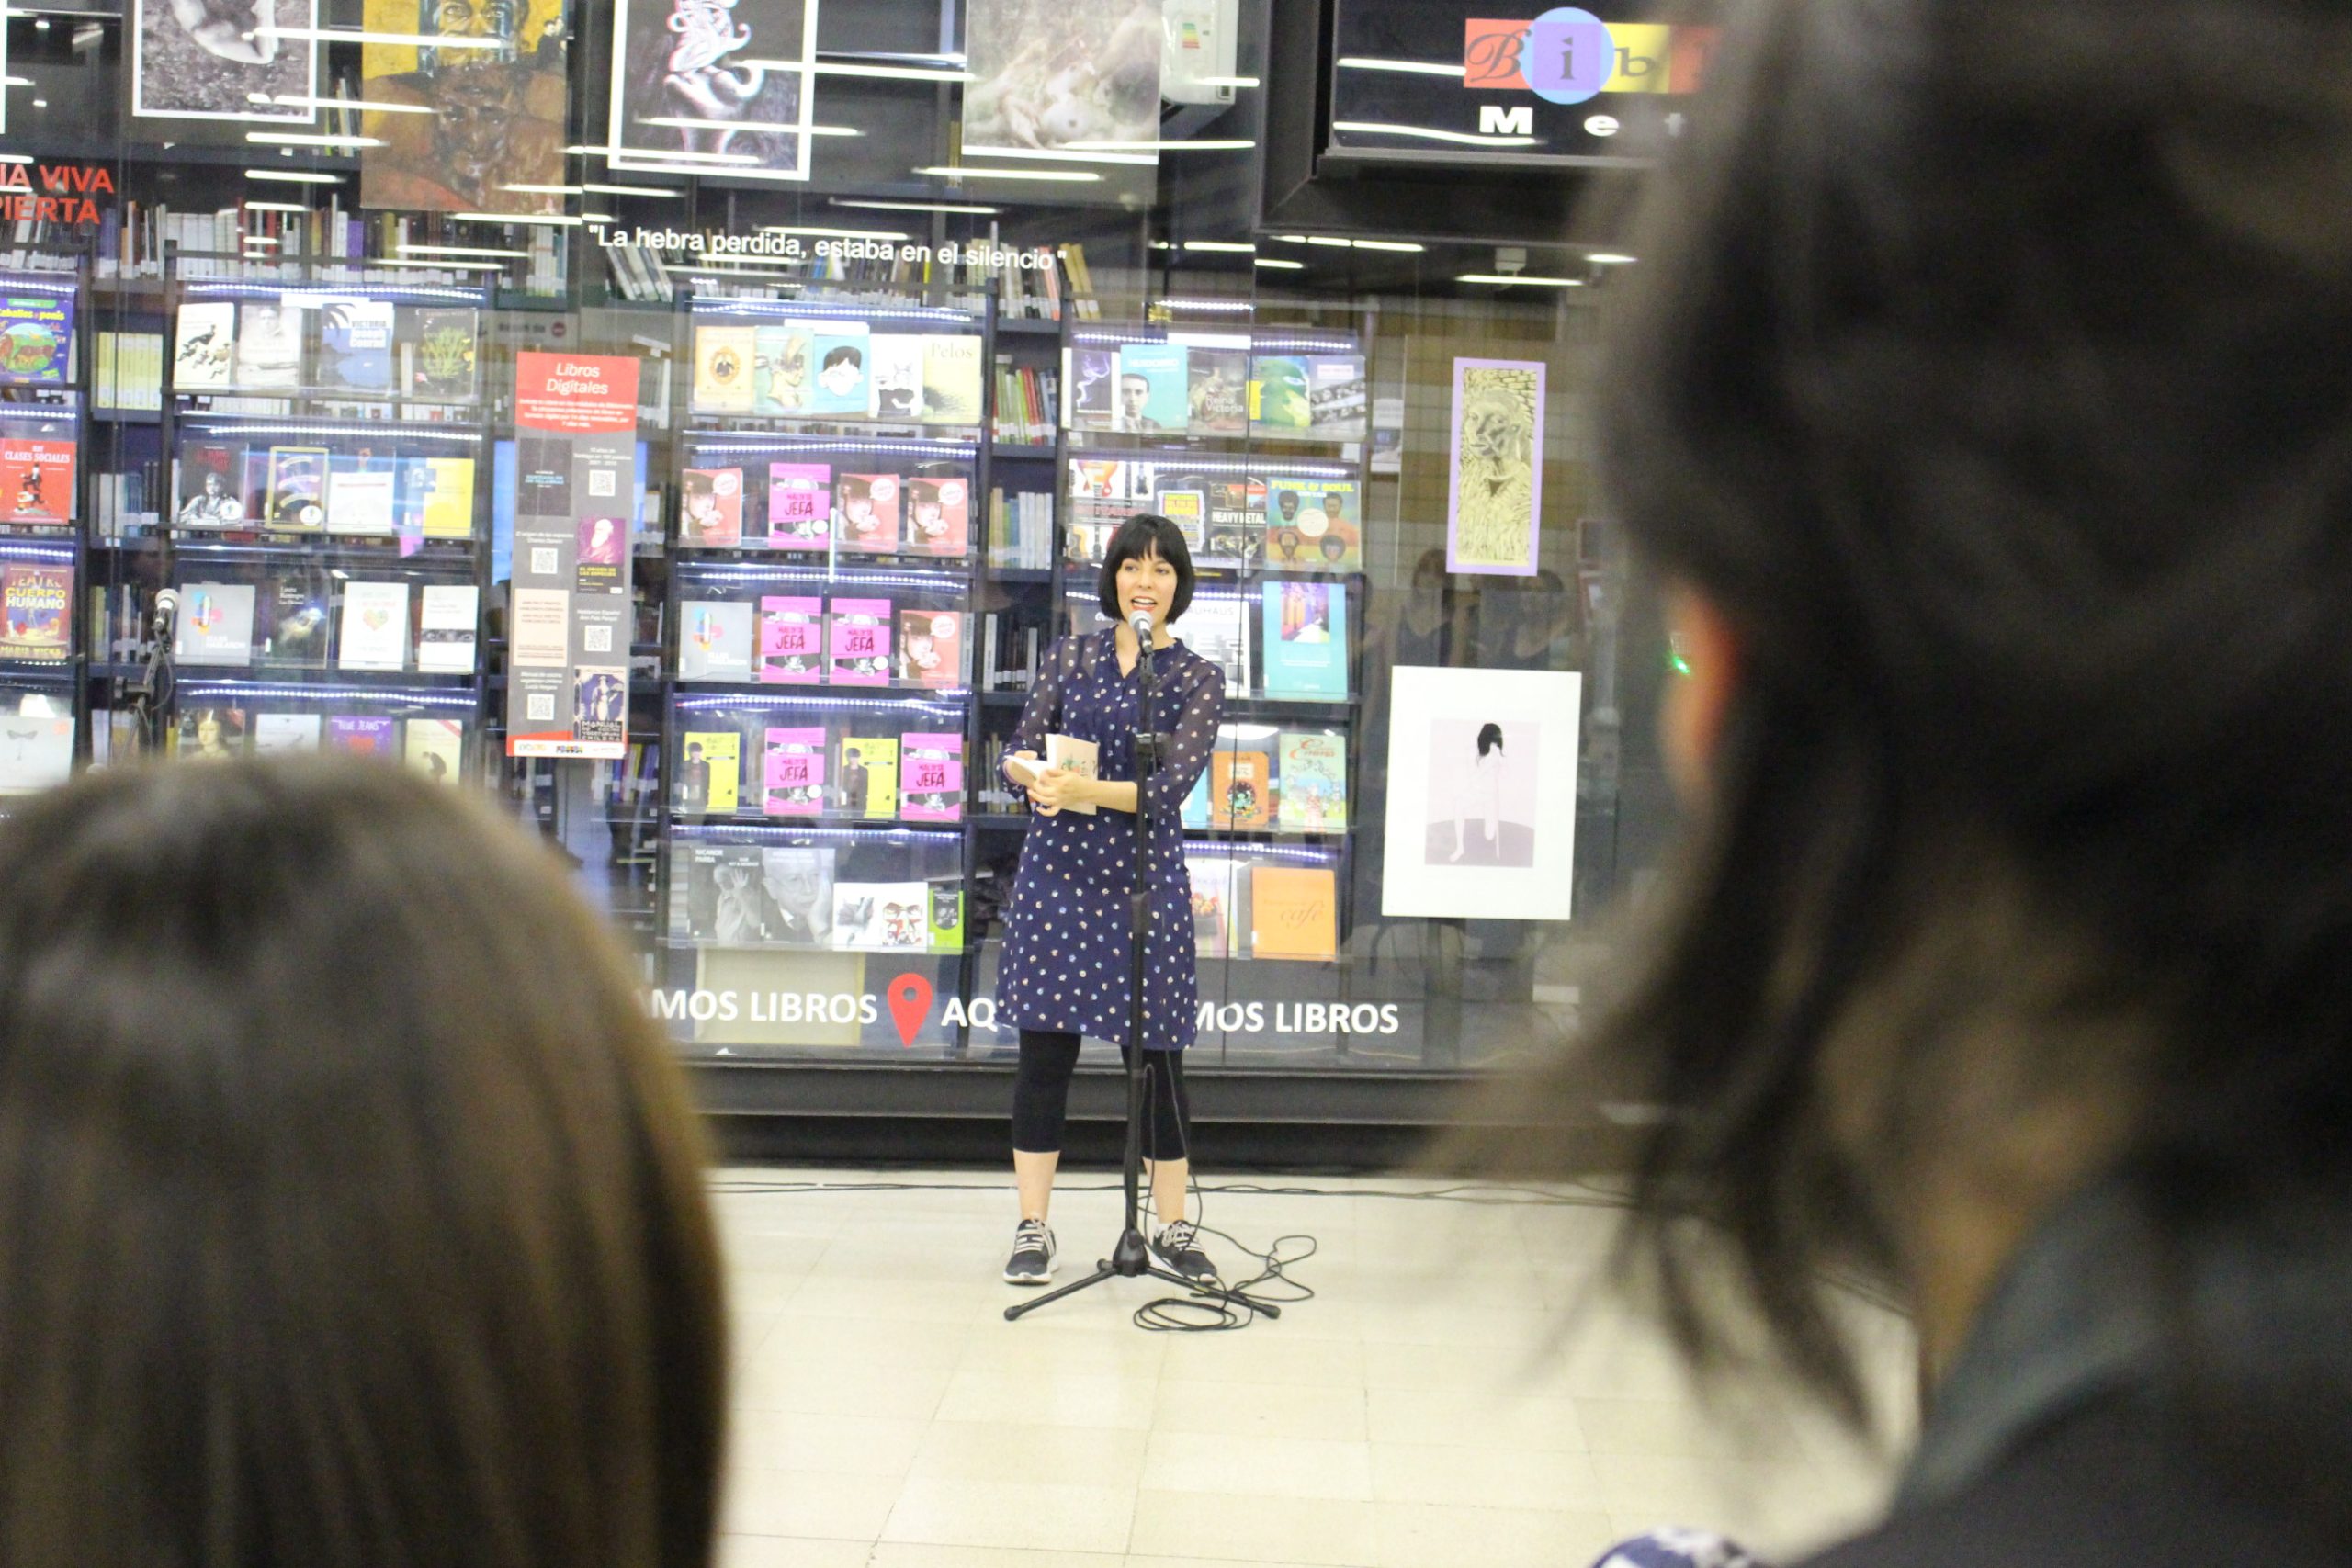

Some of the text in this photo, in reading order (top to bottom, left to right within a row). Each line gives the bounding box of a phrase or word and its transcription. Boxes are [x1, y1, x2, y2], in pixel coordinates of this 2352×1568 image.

[39, 164, 115, 194] VIVA
[0, 195, 102, 225] IERTA
[588, 224, 628, 248] "La
[636, 227, 704, 251] hebra
[712, 232, 808, 259] perdida,
[814, 238, 894, 260] estaba
[901, 247, 931, 263] en
[937, 244, 958, 265] el
[931, 342, 974, 359] Pelos
[555, 362, 601, 378] Libros
[545, 378, 609, 396] Digitales
[35, 453, 71, 463] SOCIALES
[1321, 483, 1354, 492] SOUL
[785, 501, 814, 516] JEFA
[1213, 512, 1239, 523] HEAVY
[5, 587, 66, 599] CUERPO
[6, 596, 66, 610] HUMANO
[775, 634, 806, 649] JEFA
[844, 637, 875, 652] JEFA
[779, 765, 808, 782] JEFA
[915, 771, 945, 788] JEFA
[750, 992, 877, 1024] LIBROS
[1275, 1002, 1399, 1033] LIBROS
